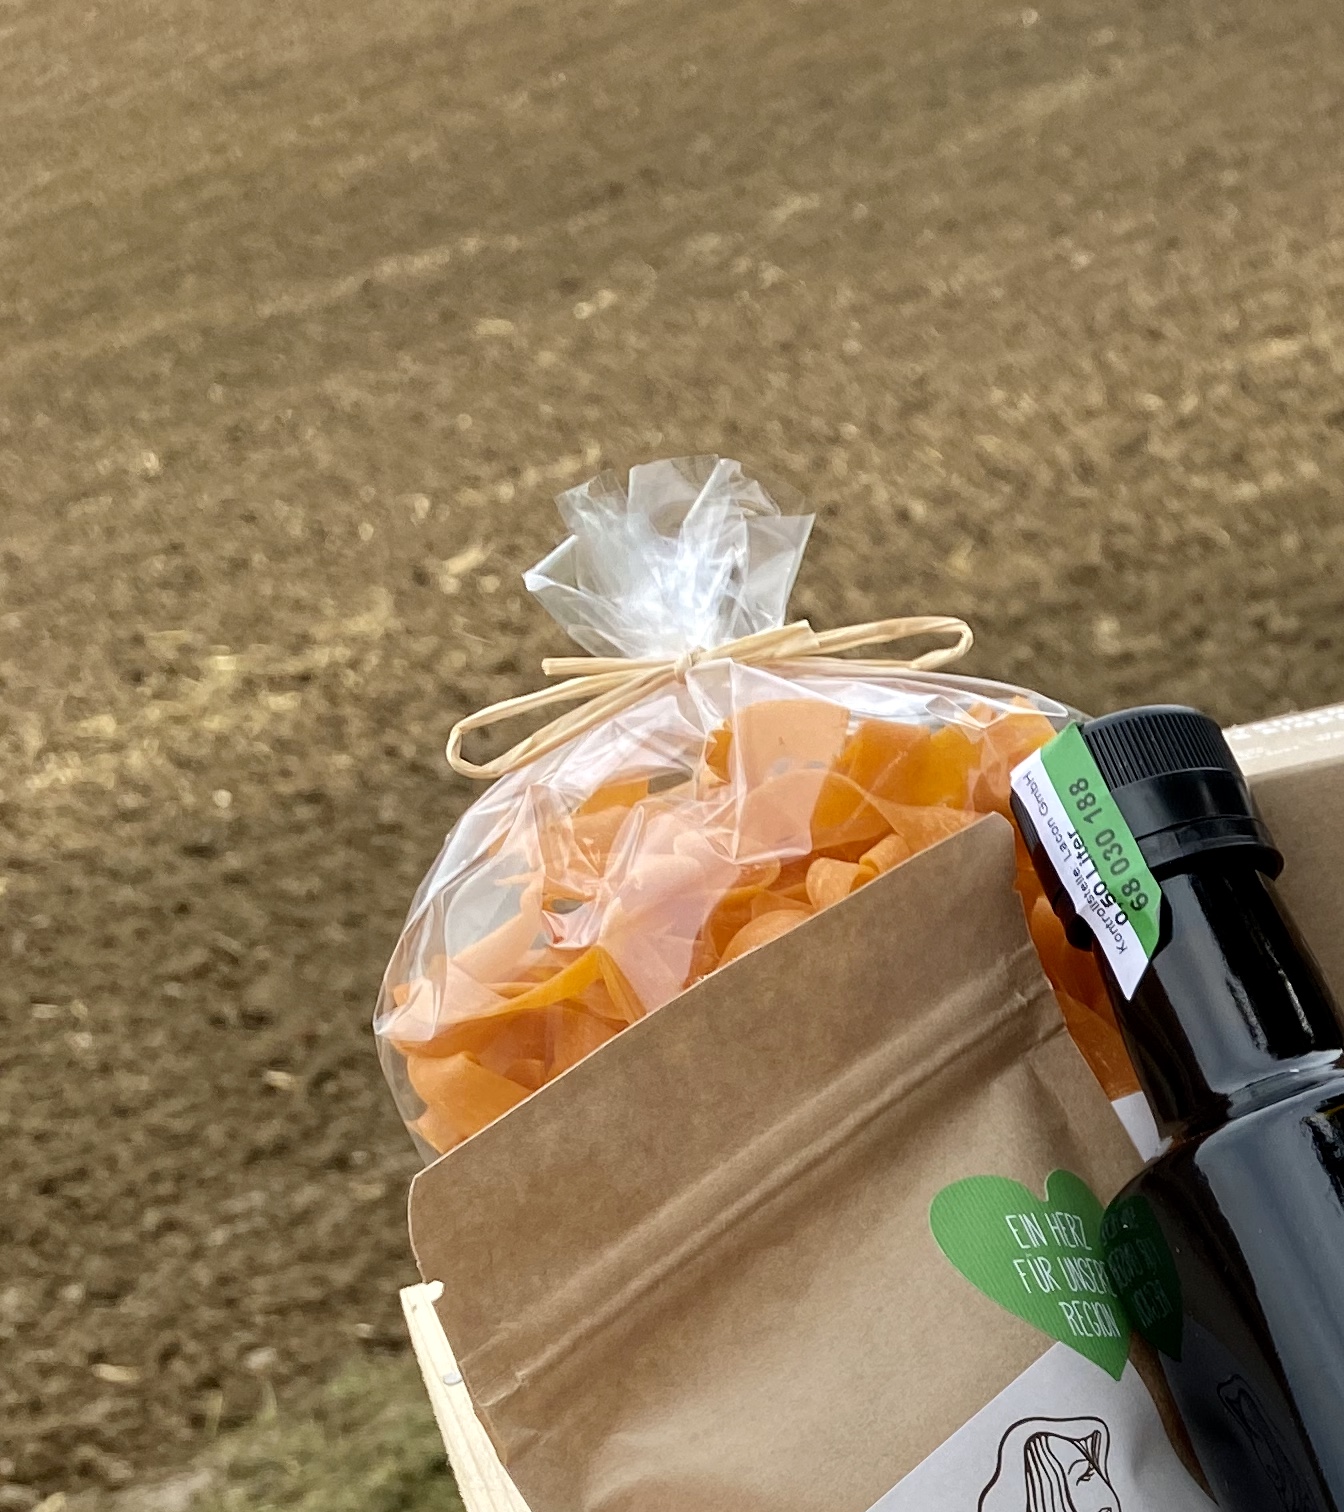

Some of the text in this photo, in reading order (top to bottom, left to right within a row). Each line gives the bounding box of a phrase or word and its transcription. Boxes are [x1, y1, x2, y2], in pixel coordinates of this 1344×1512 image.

[1022, 770, 1049, 816] GmbH
[1047, 816, 1073, 862] Lacon
[1069, 777, 1149, 912] 68 030 188
[1066, 829, 1129, 926] 0,50 Liter
[1004, 1212, 1048, 1249] EIN
[1044, 1212, 1093, 1250] HERZ
[1012, 1253, 1062, 1294] FÜR
[1056, 1256, 1118, 1298] UNSERE
[1058, 1300, 1121, 1338] REGION
